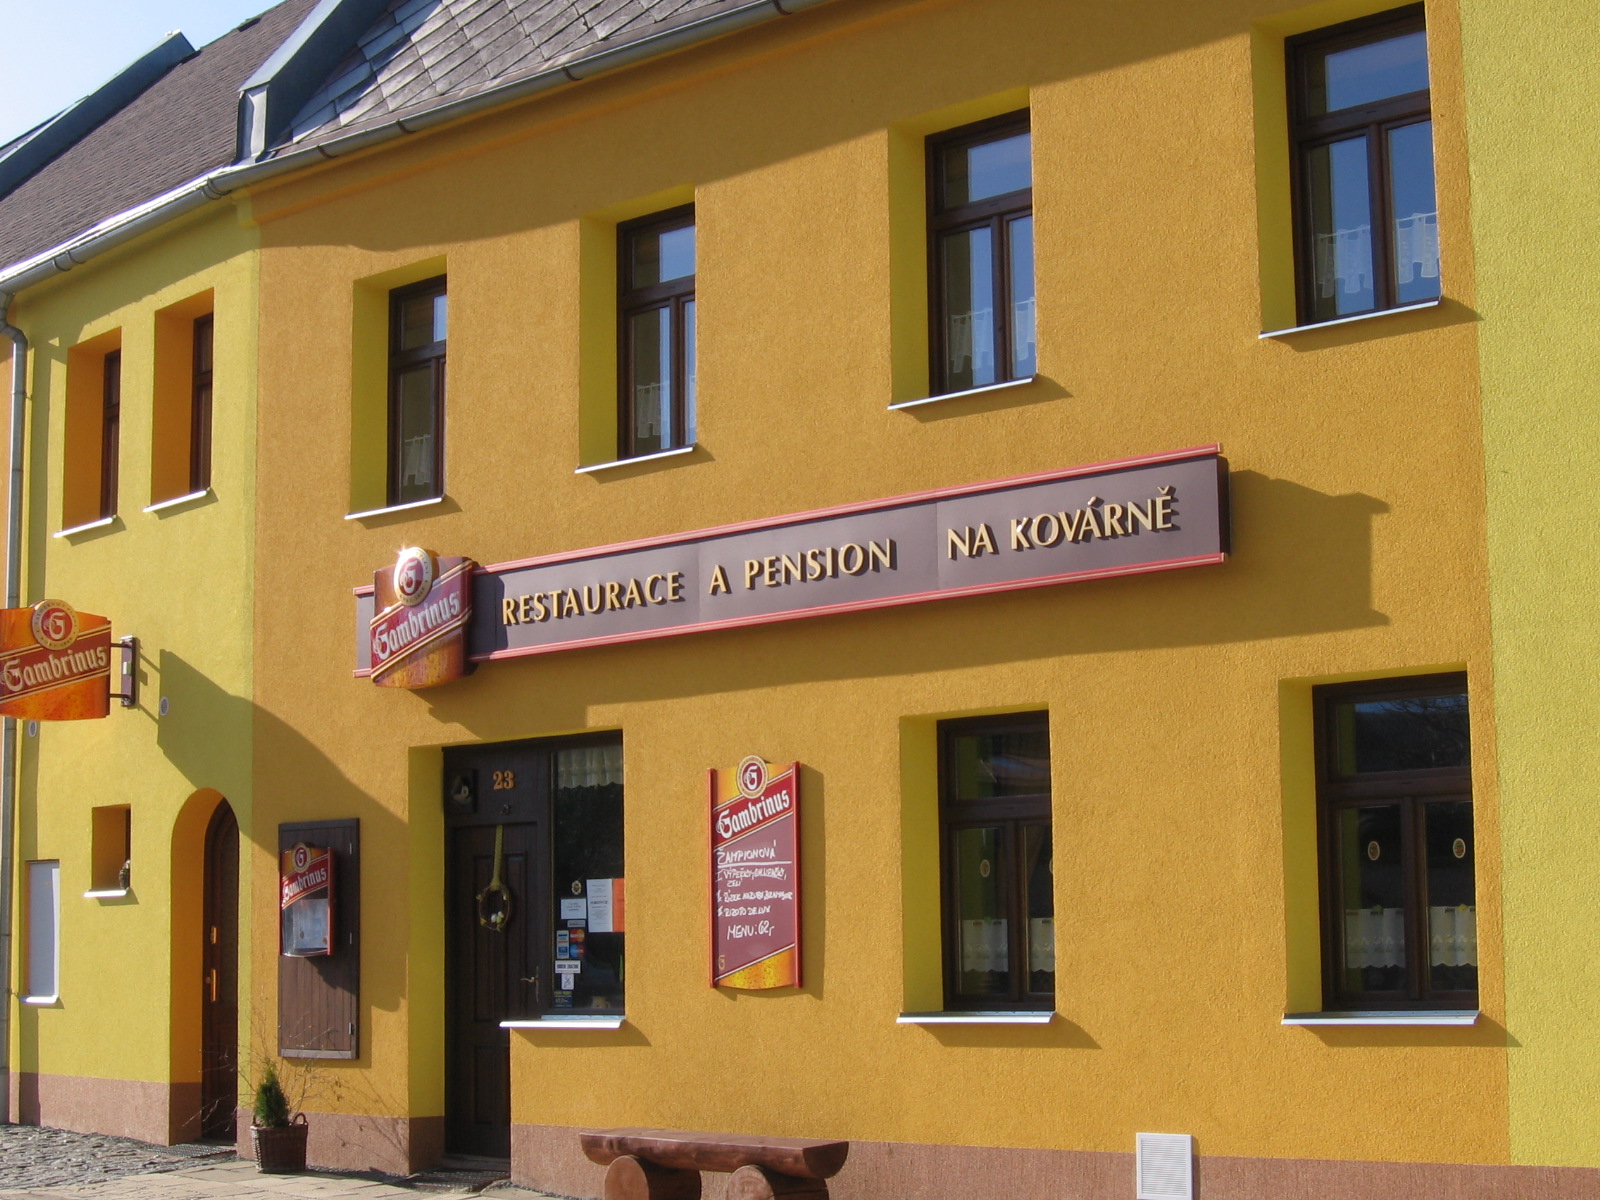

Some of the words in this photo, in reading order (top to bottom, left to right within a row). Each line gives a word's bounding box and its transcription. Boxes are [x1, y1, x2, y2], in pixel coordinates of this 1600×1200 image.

[502, 571, 685, 626] RESTAURACE
[708, 564, 730, 595] A
[744, 538, 894, 590] PENSION
[947, 523, 995, 559] NA
[1010, 485, 1174, 550] KOVÁRNĚ
[373, 592, 460, 660] Gambrinus
[1, 647, 108, 692] Gambrinus
[493, 770, 515, 790] 23
[716, 789, 790, 839] Gambrinus
[283, 868, 327, 902] Gambrinus
